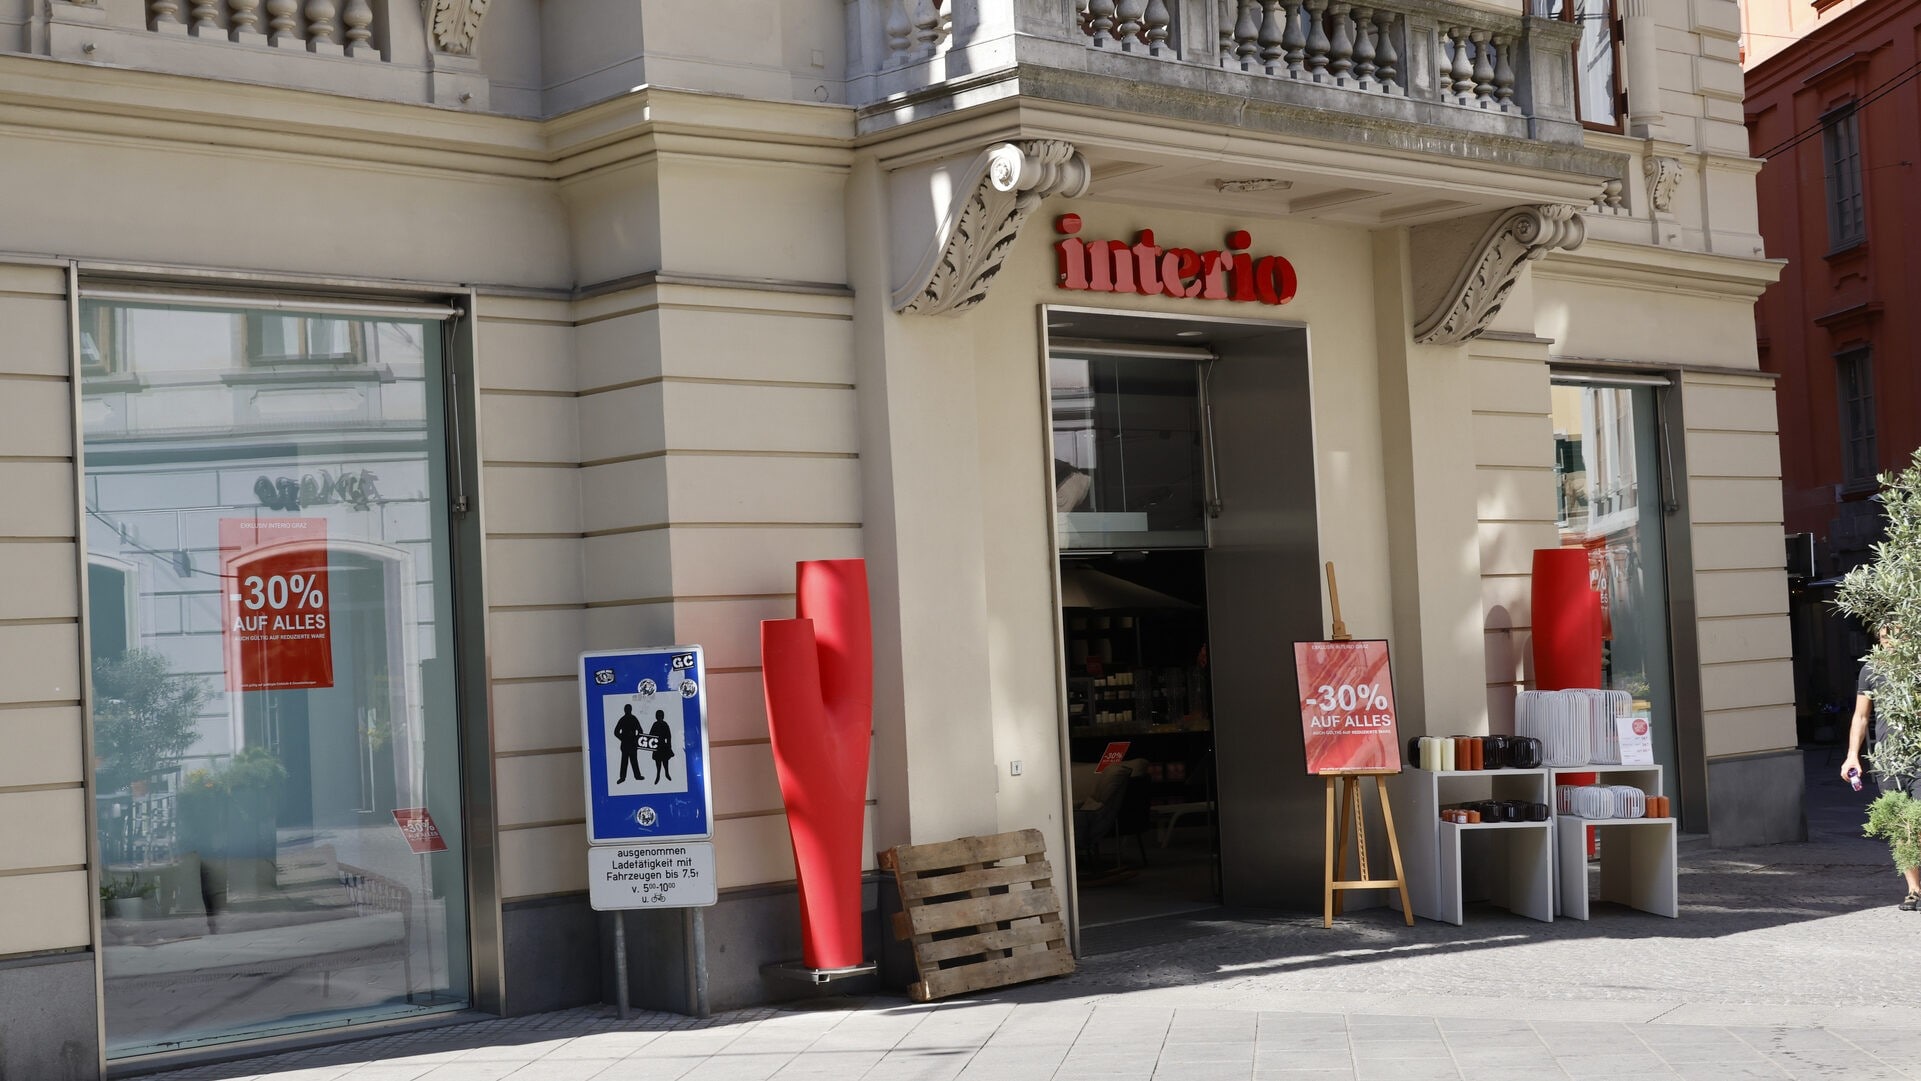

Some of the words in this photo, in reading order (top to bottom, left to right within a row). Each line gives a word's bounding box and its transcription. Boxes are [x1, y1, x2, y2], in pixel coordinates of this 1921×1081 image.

[1055, 212, 1298, 305] interio
[229, 574, 324, 610] -30%
[233, 615, 268, 632] AUF
[272, 613, 326, 631] ALLES
[672, 655, 694, 668] GC
[1306, 683, 1388, 712] -30%
[1310, 715, 1341, 728] AUF
[1344, 714, 1392, 727] ALLES
[637, 736, 659, 749] GC
[617, 847, 686, 858] ausgenommen
[612, 859, 673, 870] Ladetätigkeit
[676, 858, 692, 867] mit
[606, 871, 662, 882] Fahrzeugen
[665, 870, 679, 879] bis
